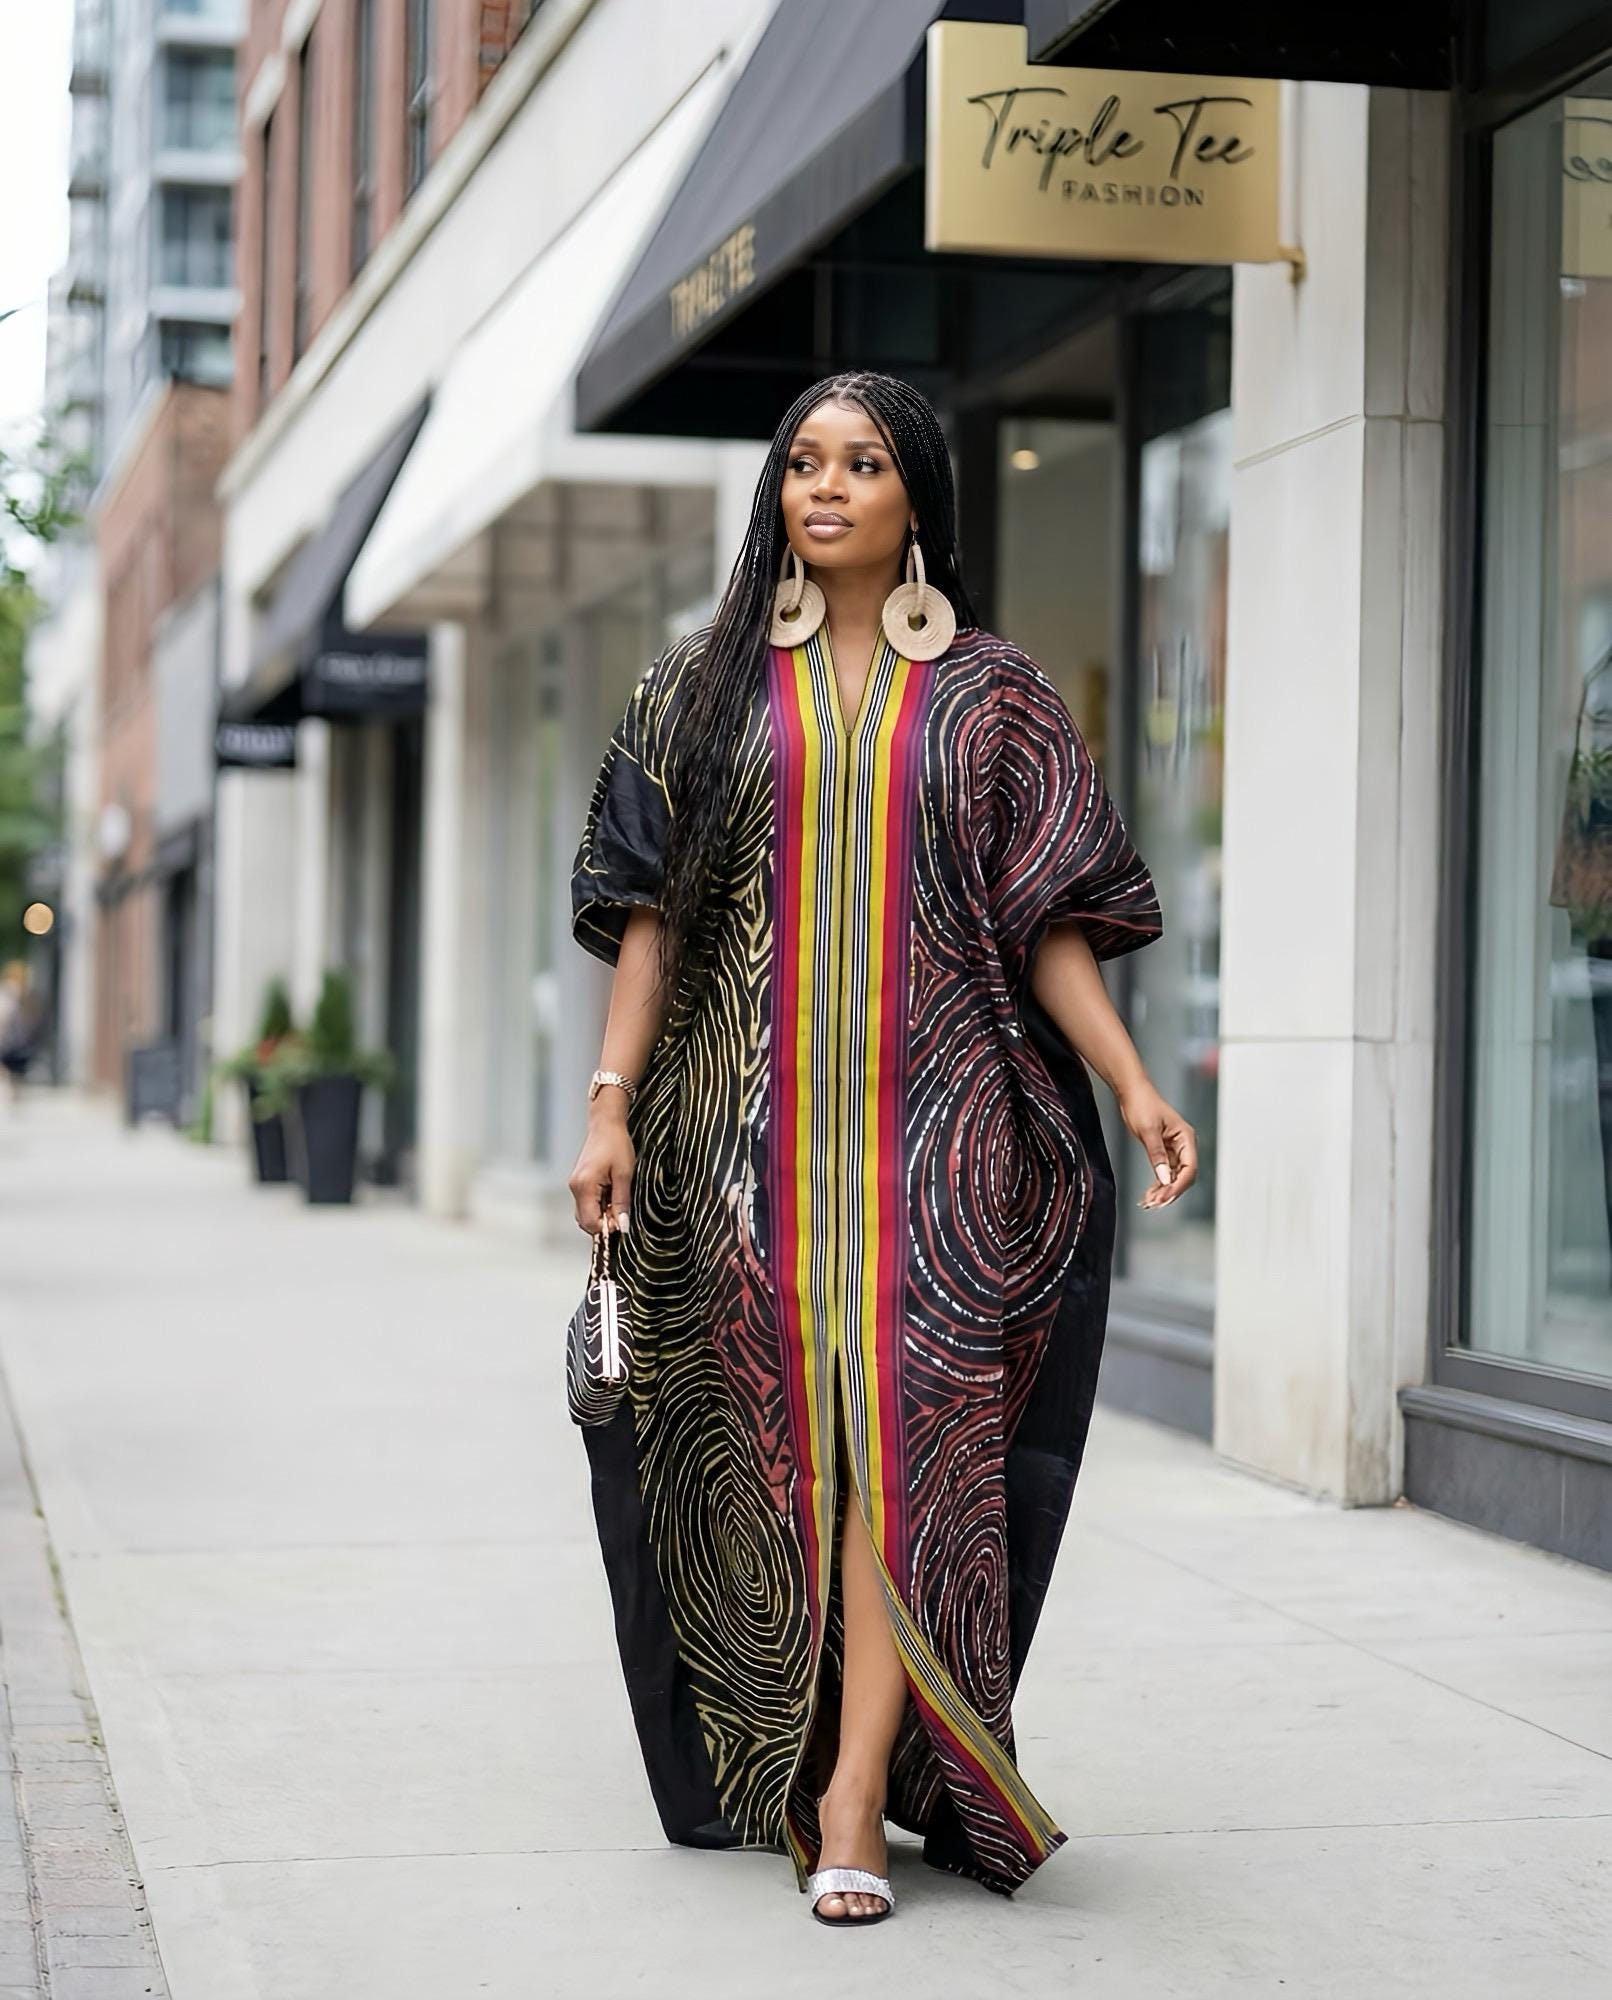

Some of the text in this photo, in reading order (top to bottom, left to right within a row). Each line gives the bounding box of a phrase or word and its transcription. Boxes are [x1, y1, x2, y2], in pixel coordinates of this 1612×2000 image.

[967, 87, 1256, 192] Triple Tee
[1062, 180, 1204, 206] FASHION
